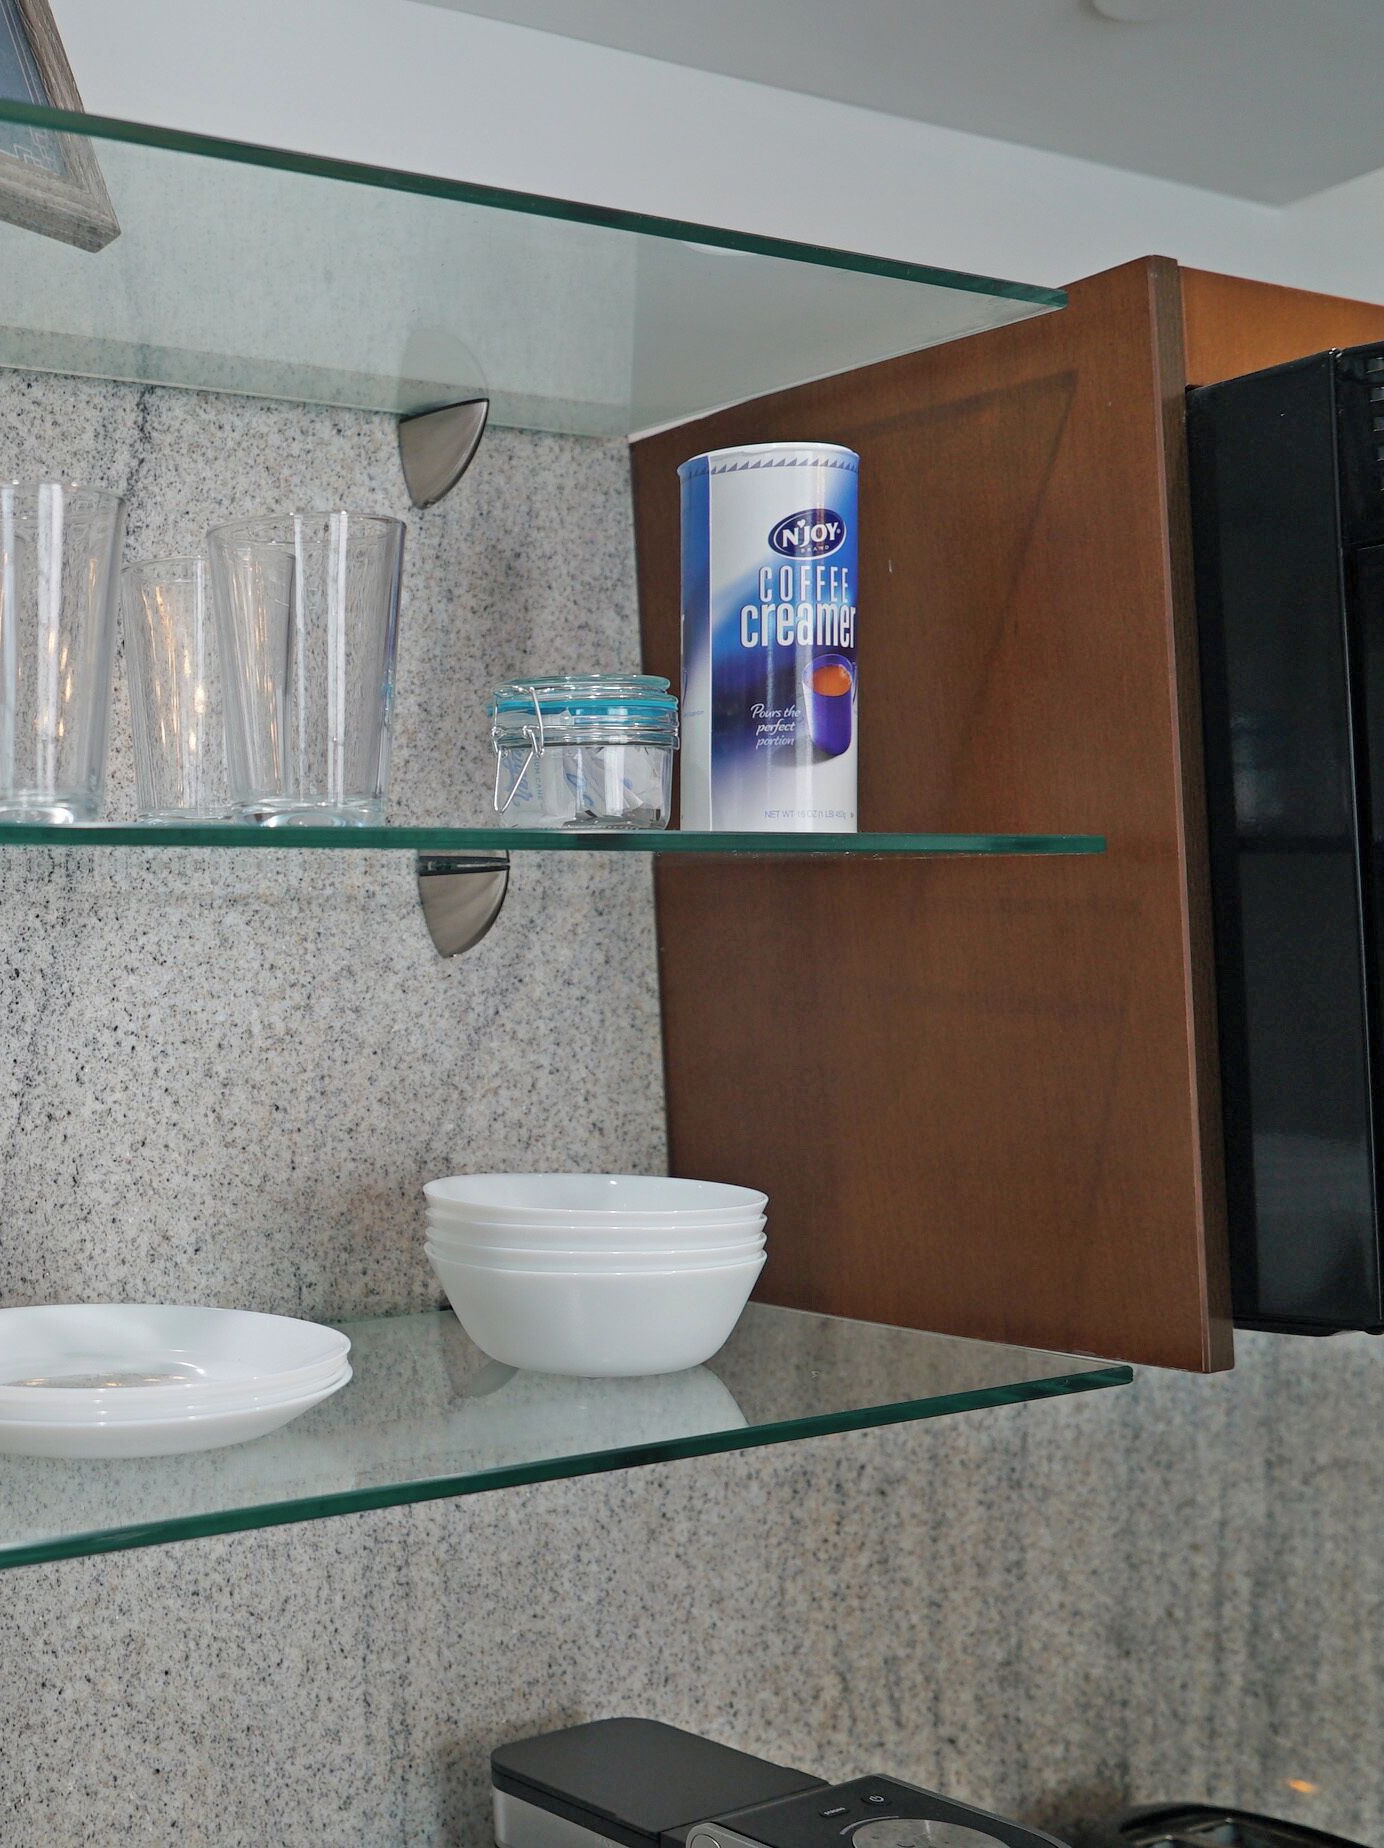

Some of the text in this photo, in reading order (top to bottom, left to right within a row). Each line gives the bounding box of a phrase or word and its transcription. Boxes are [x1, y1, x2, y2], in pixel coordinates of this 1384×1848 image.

[759, 565, 849, 602] COFFEE
[740, 602, 856, 649] creamer
[750, 703, 801, 719] Pours the
[755, 718, 796, 736] perfect
[755, 735, 795, 750] portion
[764, 809, 781, 818] NET
